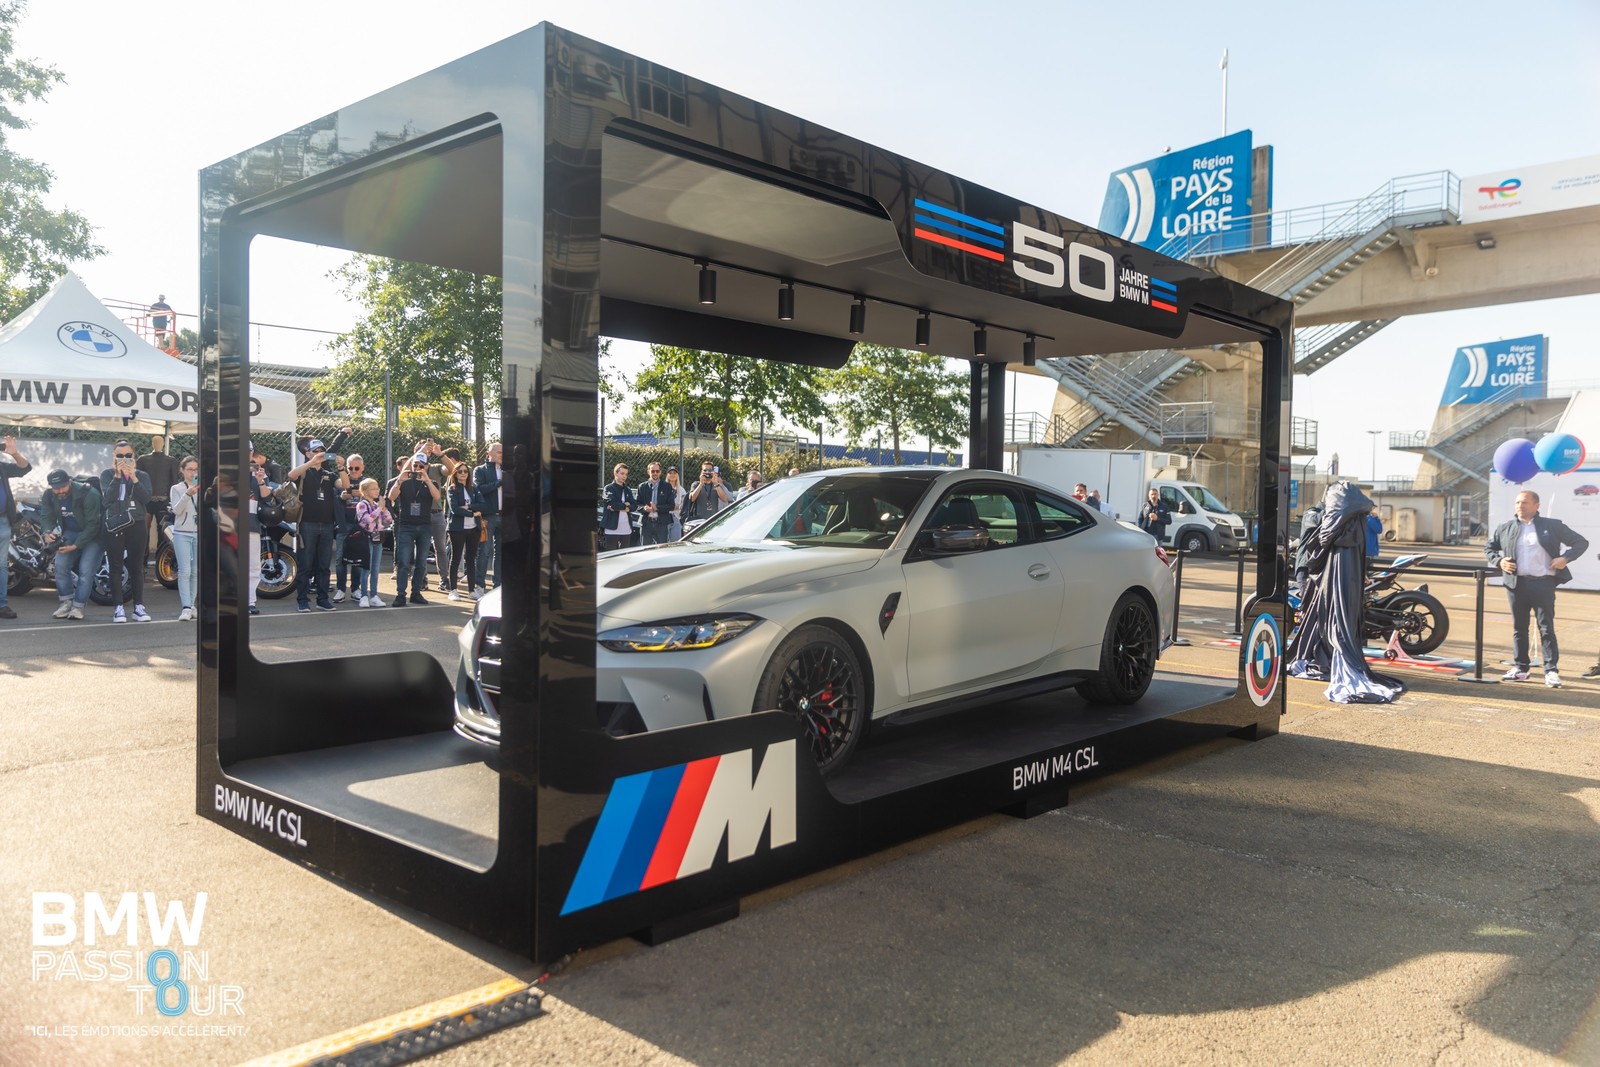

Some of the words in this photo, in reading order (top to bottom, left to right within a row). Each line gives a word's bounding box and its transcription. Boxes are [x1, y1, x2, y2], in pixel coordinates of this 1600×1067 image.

[1193, 154, 1234, 170] Région
[1171, 167, 1233, 200] PAYS
[1205, 194, 1220, 207] de
[1222, 193, 1233, 204] la
[1162, 206, 1233, 239] LOIRE
[1013, 221, 1115, 302] 50
[1120, 267, 1149, 290] JAHRE
[1120, 283, 1141, 303] BMW
[1141, 290, 1149, 305] M
[64, 323, 113, 338] BMW
[1510, 344, 1536, 352] Région
[1496, 352, 1535, 367] PAYS
[1490, 372, 1535, 387] LOIRE
[0, 379, 69, 404] MW
[82, 383, 262, 417] MOTORD
[1013, 758, 1049, 791] BMW
[1052, 752, 1072, 778] M4
[1075, 746, 1099, 771] CSL
[215, 784, 250, 822] BMW
[252, 798, 273, 833] M4
[277, 808, 307, 847] CSL
